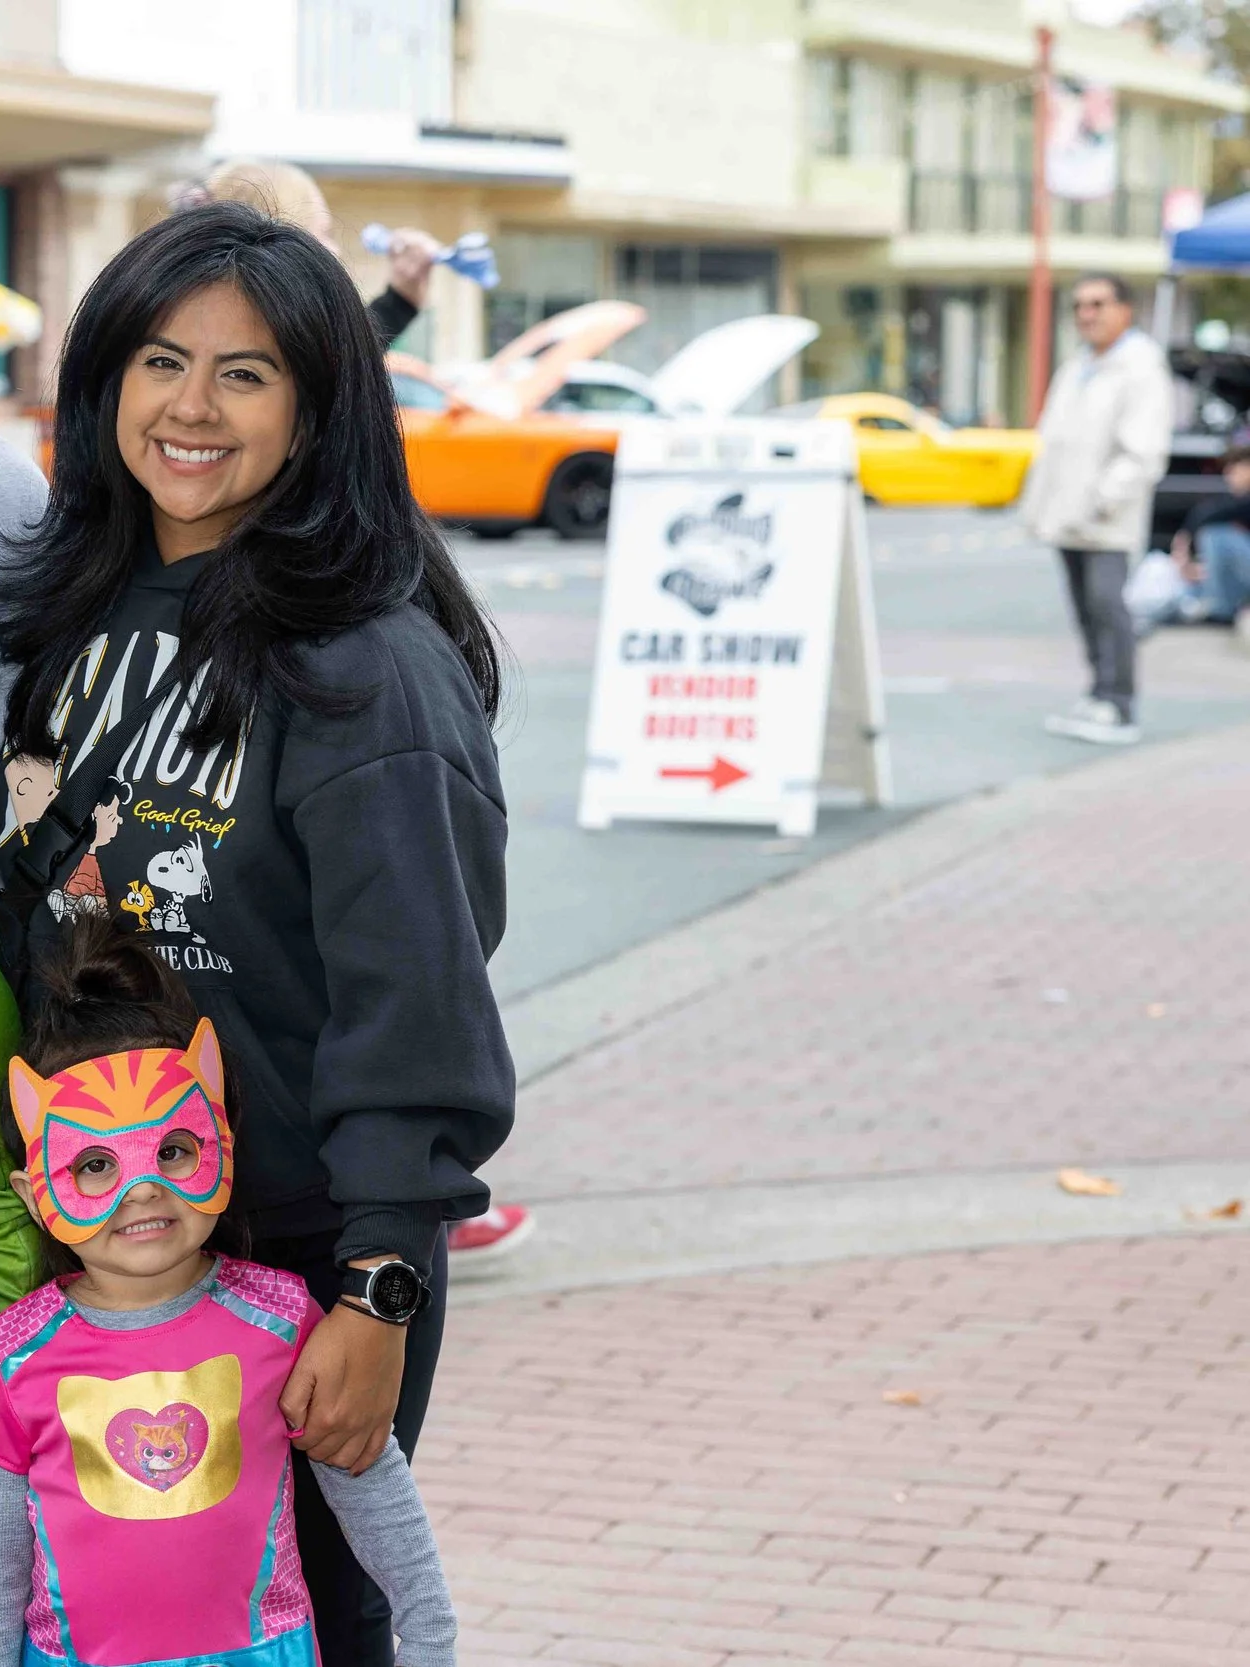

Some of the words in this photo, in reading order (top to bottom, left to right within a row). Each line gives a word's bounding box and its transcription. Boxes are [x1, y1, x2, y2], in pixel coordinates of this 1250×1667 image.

[622, 633, 683, 663] CAR
[701, 634, 802, 664] SHOW
[133, 799, 181, 823] Good
[180, 809, 236, 843] Grief
[183, 946, 233, 974] CLUB
